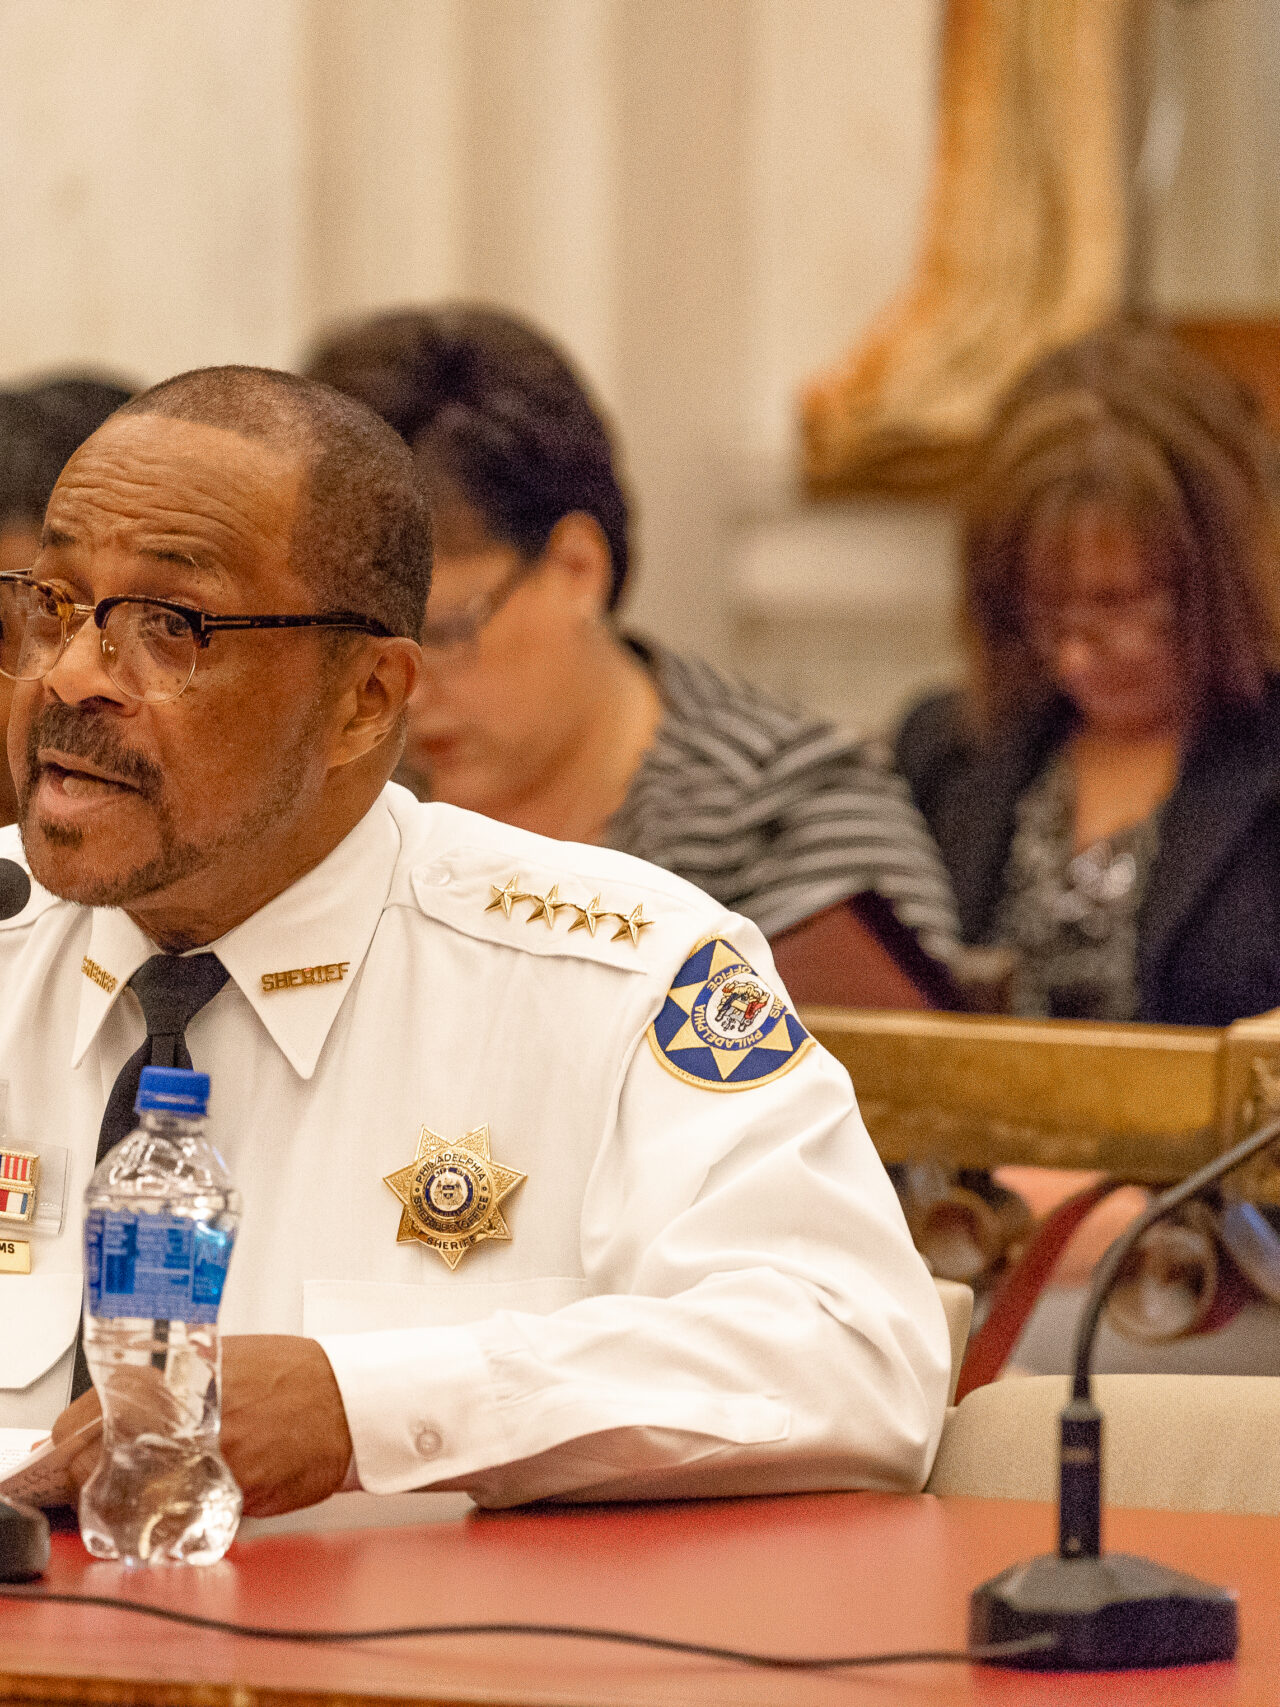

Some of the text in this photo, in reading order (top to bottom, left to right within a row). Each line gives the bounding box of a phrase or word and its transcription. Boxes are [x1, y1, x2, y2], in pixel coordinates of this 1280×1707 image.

[261, 962, 350, 992] SHERIFF
[706, 965, 753, 992] OFFICE
[694, 1003, 764, 1049] PHILADELPHIA
[415, 1153, 486, 1183] PHILADELPHIA
[427, 1236, 475, 1250] SHERIFF
